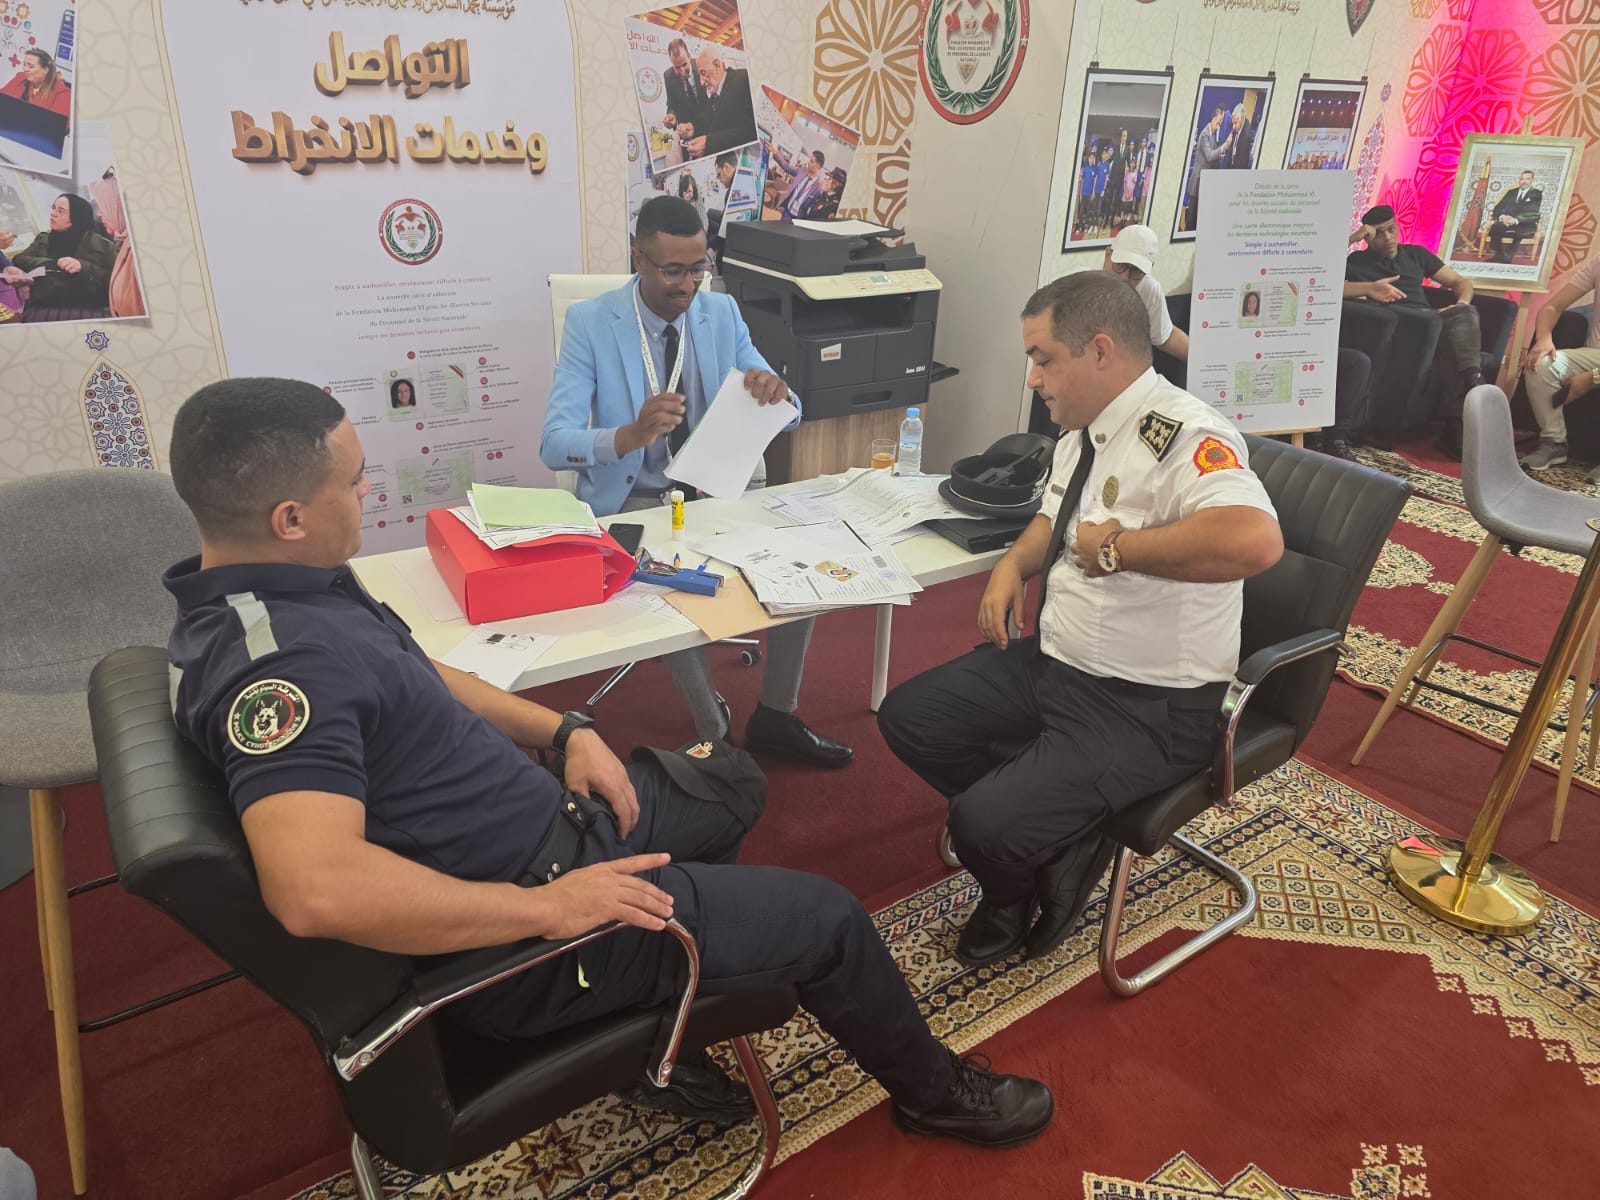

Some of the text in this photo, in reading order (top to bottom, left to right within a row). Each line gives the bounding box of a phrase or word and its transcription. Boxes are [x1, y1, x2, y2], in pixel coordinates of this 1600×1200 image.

[314, 30, 470, 99] التواصل
[231, 110, 548, 176] وخدمات الانخراط
[233, 721, 246, 742] POLICE
